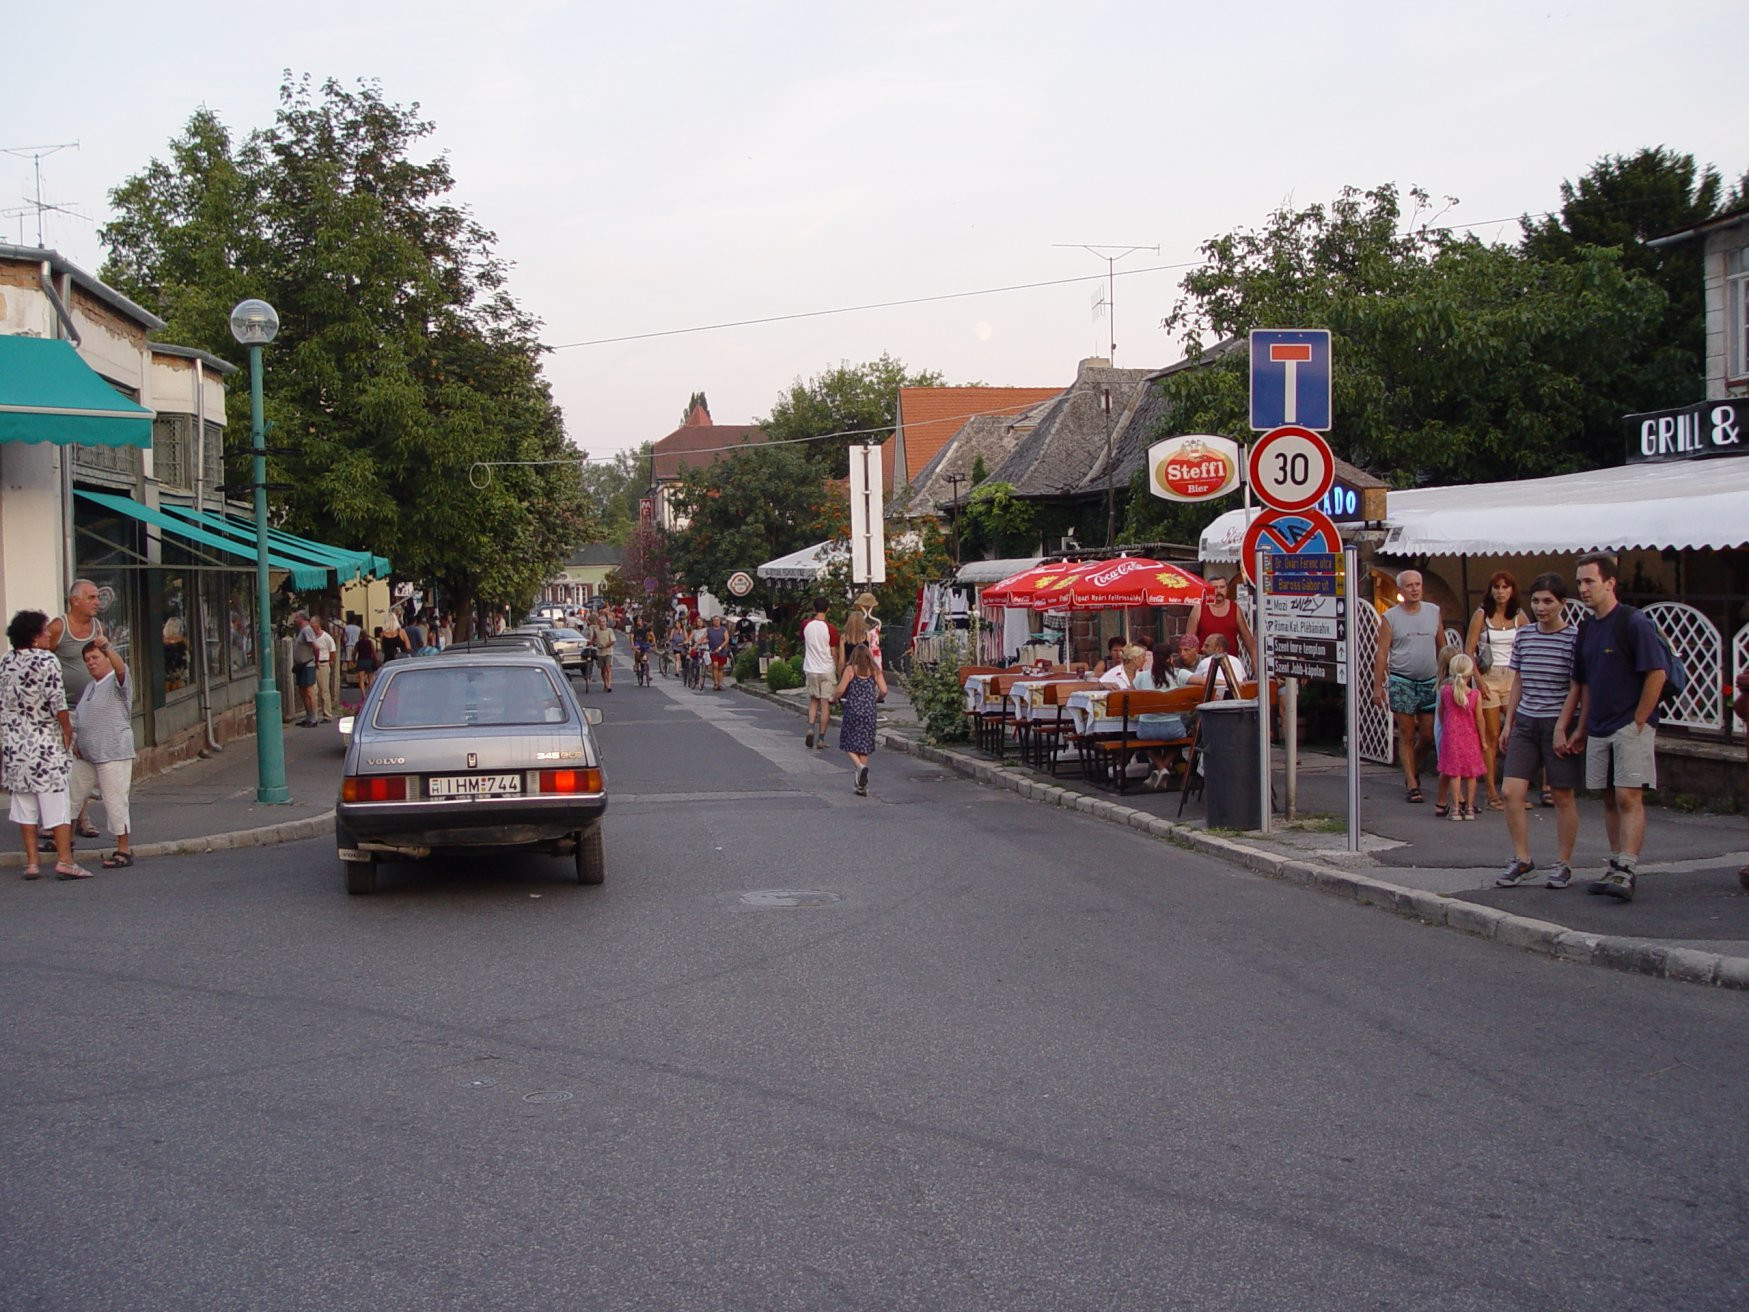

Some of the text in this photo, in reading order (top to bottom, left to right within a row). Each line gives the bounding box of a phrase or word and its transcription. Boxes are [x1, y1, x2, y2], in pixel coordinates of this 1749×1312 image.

[1641, 405, 1739, 456] GRILL &
[1167, 461, 1225, 480] Steffl
[1274, 452, 1309, 485] 30
[1187, 484, 1209, 493] Bier
[1314, 486, 1356, 515] ADO
[1300, 557, 1318, 569] Ferenc
[1320, 558, 1331, 569] utca
[1086, 560, 1147, 588] Coca-Cola
[1278, 578, 1300, 591] Baross
[1301, 578, 1320, 591] Gábor
[1274, 600, 1288, 611] Mozi
[1275, 640, 1289, 652] Szent
[1303, 642, 1326, 658] templom
[1275, 661, 1290, 673] Szent
[367, 757, 406, 766] VOLVO
